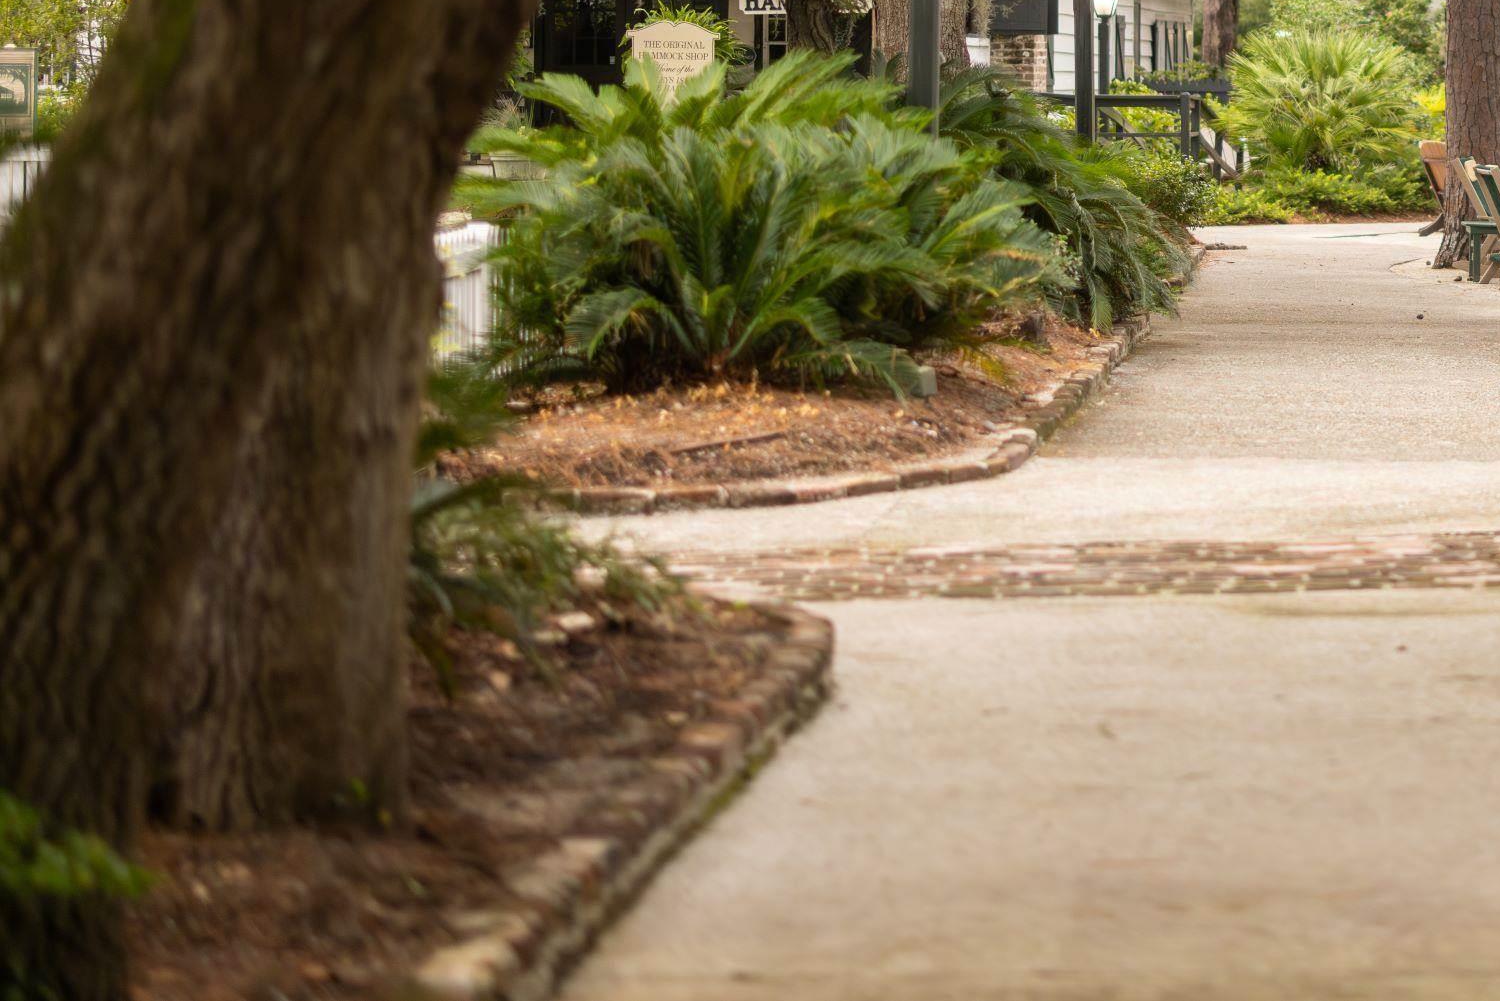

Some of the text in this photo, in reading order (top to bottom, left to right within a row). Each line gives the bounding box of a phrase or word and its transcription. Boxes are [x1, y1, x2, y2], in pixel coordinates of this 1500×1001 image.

[643, 40, 705, 50] THE ORIGINAL
[685, 52, 709, 61] SHOP
